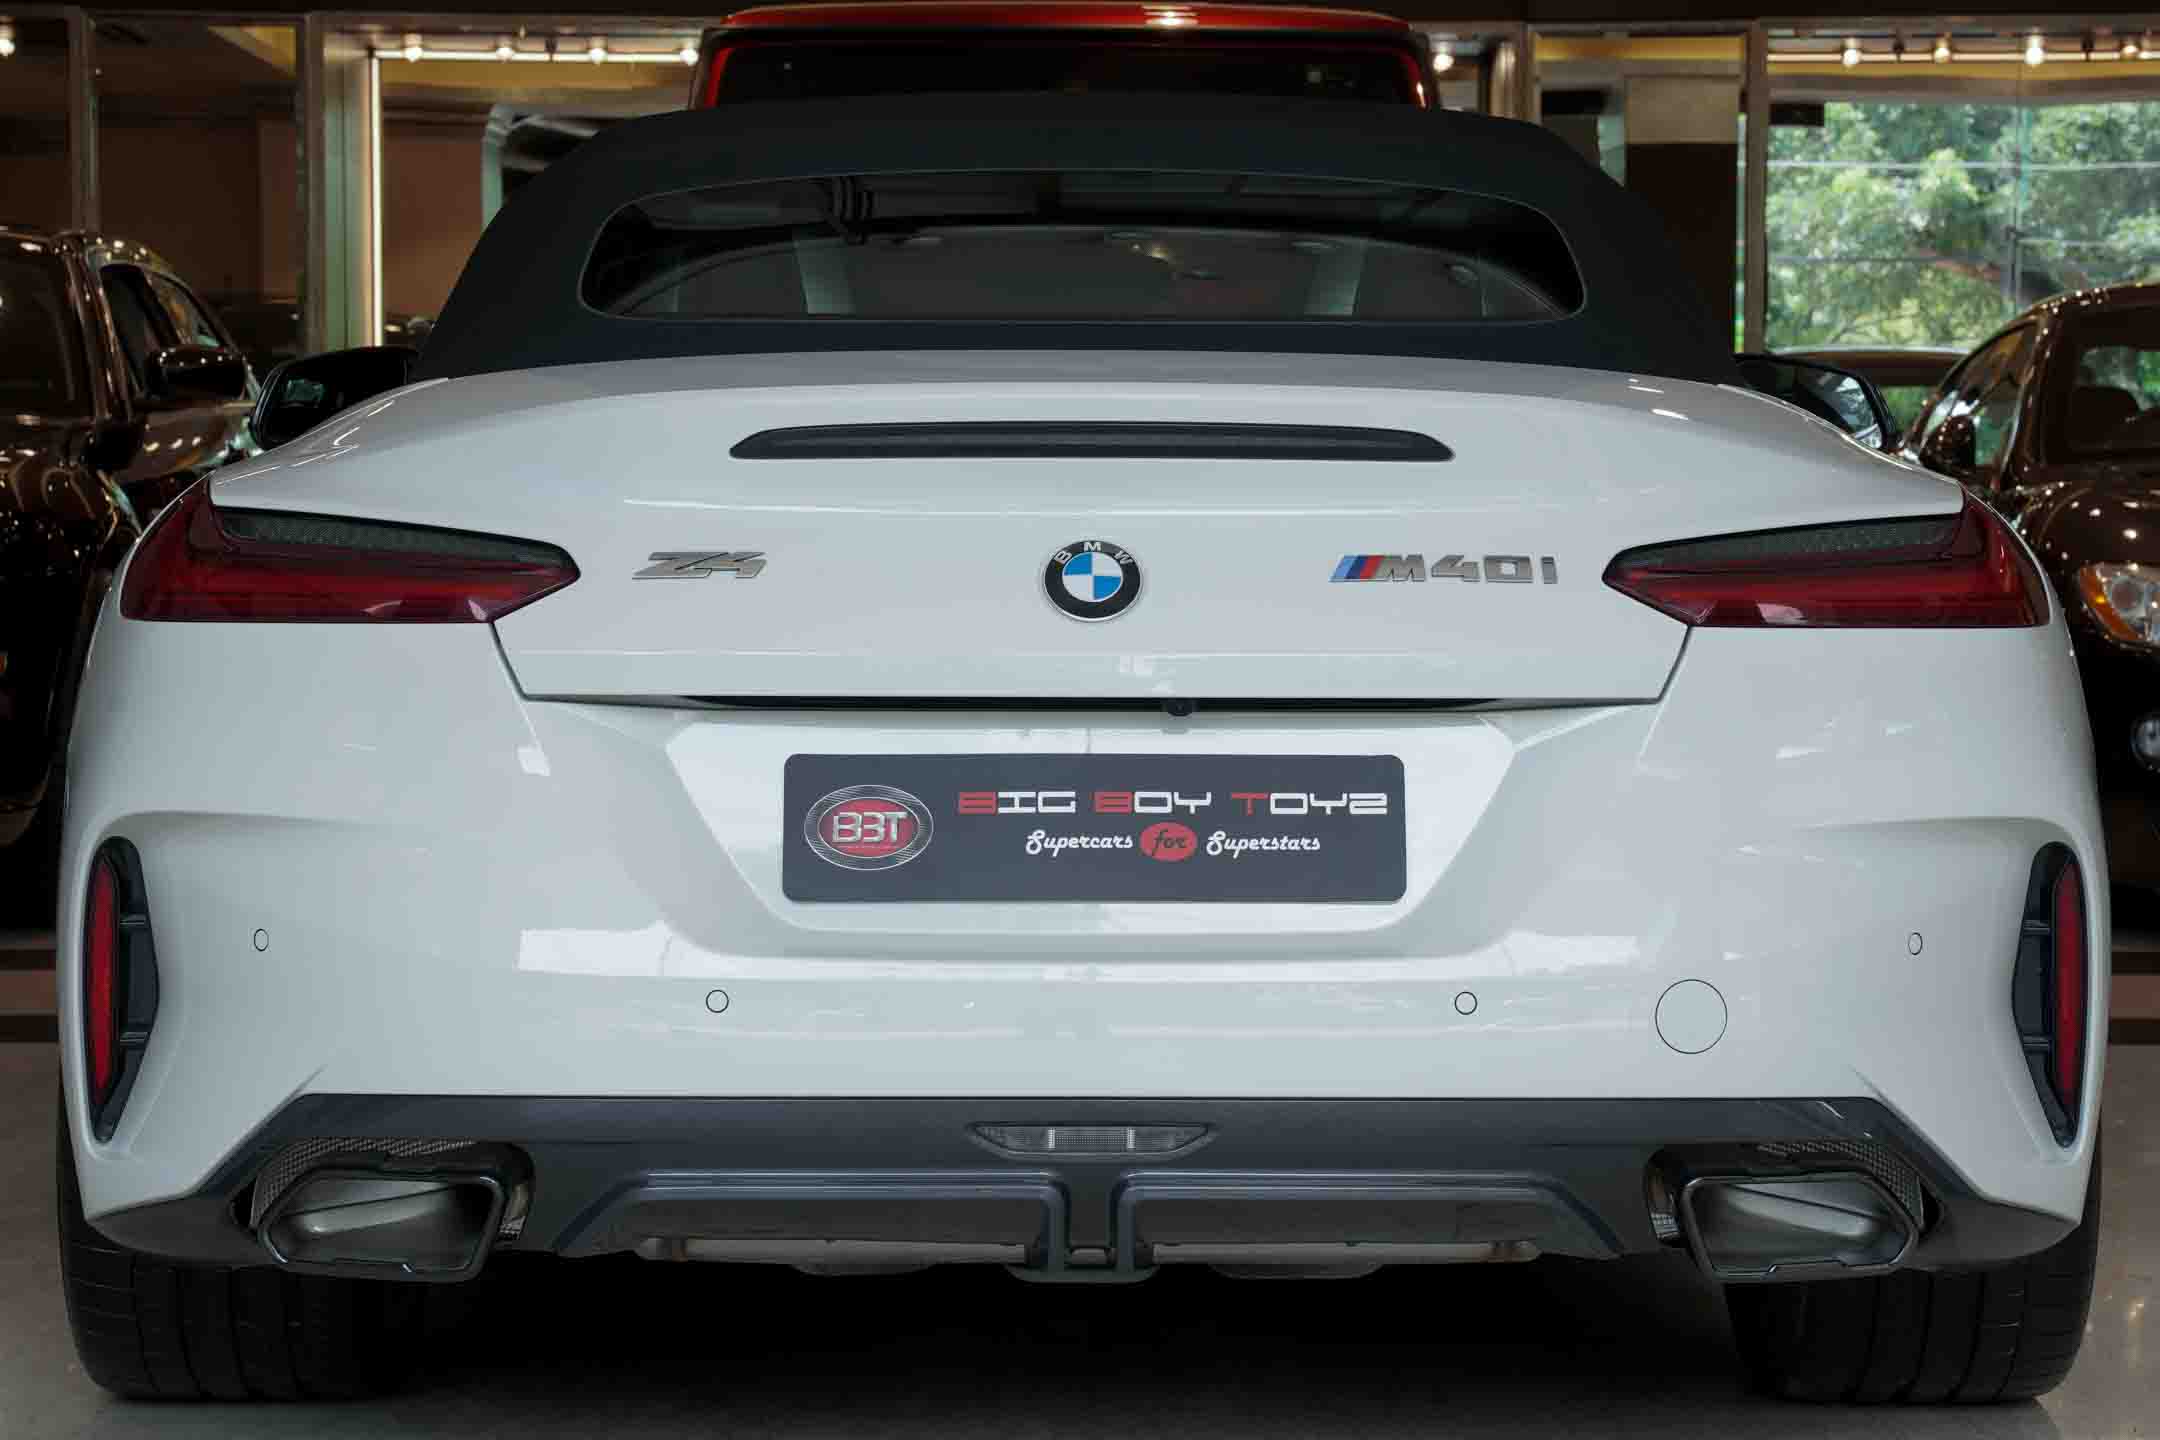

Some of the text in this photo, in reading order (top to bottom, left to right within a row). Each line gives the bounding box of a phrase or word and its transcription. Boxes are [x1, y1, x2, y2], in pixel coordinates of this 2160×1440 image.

[631, 551, 767, 580] Z4
[1053, 541, 1134, 565] BMW
[958, 791, 1076, 814] BIG
[1094, 791, 1212, 815] BOY
[832, 811, 908, 843] BBT
[1025, 828, 1321, 859] Supercars for Superstars
